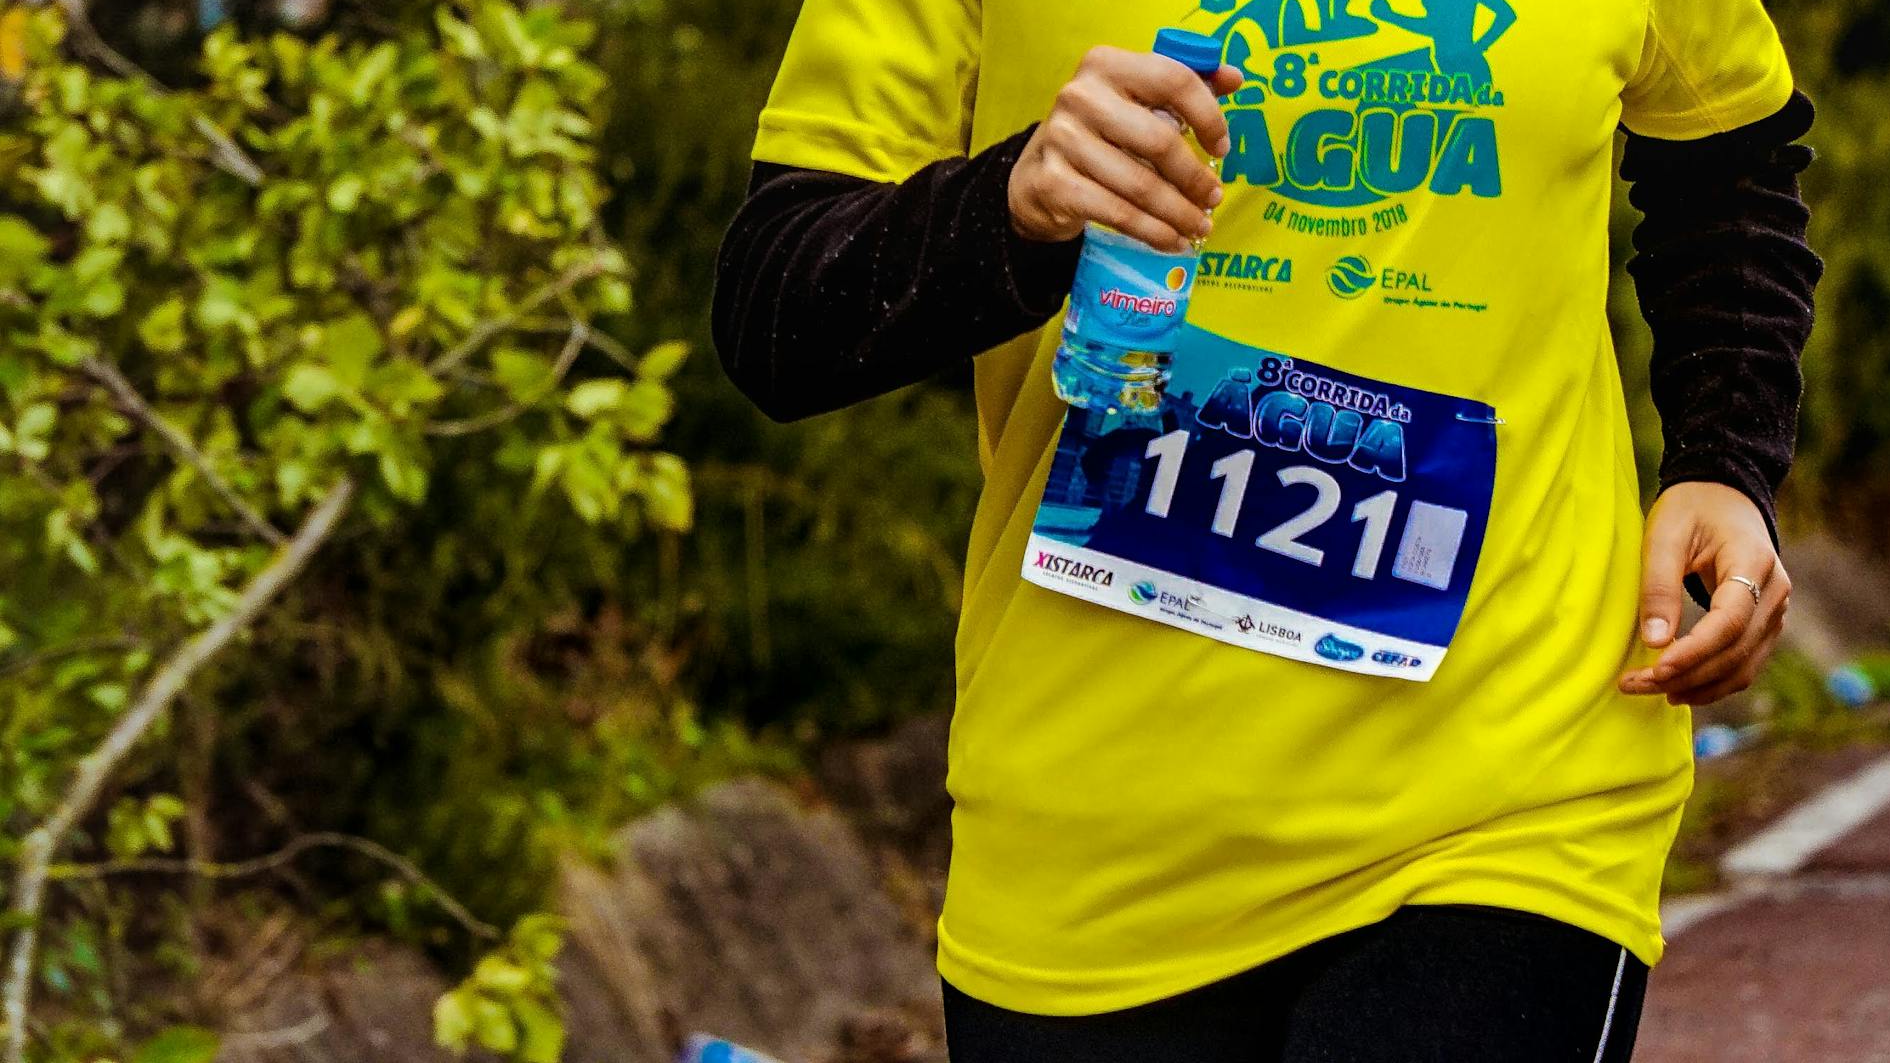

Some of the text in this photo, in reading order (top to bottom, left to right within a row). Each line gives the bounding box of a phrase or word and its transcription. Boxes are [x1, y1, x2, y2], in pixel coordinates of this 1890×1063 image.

[1318, 68, 1474, 105] CORRIDA
[1475, 81, 1505, 107] da
[1220, 86, 1502, 198] ÁGUA
[1263, 200, 1409, 238] 04 novembro 2018
[1197, 252, 1292, 283] STARCA
[1381, 268, 1432, 291] EPAL
[1100, 286, 1177, 317] vimeiro
[1285, 372, 1390, 418] CORRIDA
[1389, 403, 1412, 424] da
[1195, 366, 1407, 483] ÁGUA
[1145, 429, 1398, 581] 1121
[1034, 550, 1115, 587] XISTARCA
[1160, 591, 1192, 613] EPAL
[1258, 621, 1304, 643] LISBOA
